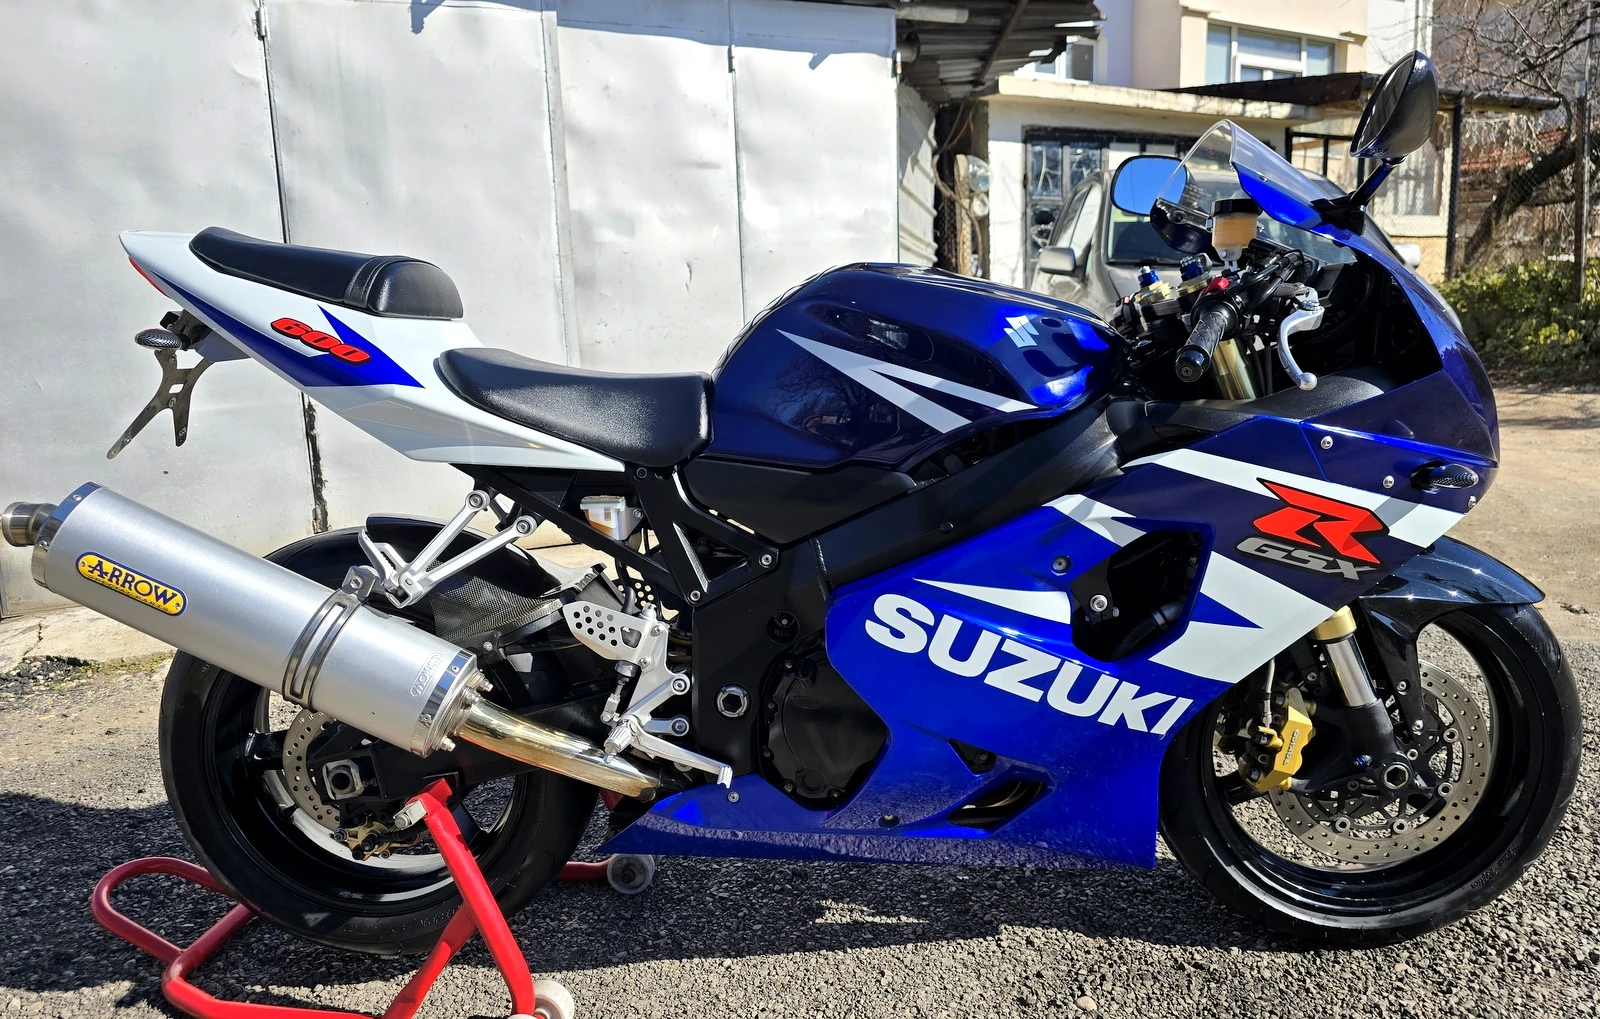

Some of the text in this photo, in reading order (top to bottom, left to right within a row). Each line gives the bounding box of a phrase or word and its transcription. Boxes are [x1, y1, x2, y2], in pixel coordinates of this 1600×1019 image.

[270, 318, 371, 364] 600
[1252, 477, 1389, 565] R
[1236, 536, 1378, 581] GSX
[87, 560, 178, 606] ARROW
[865, 594, 1194, 735] SUZUKI
